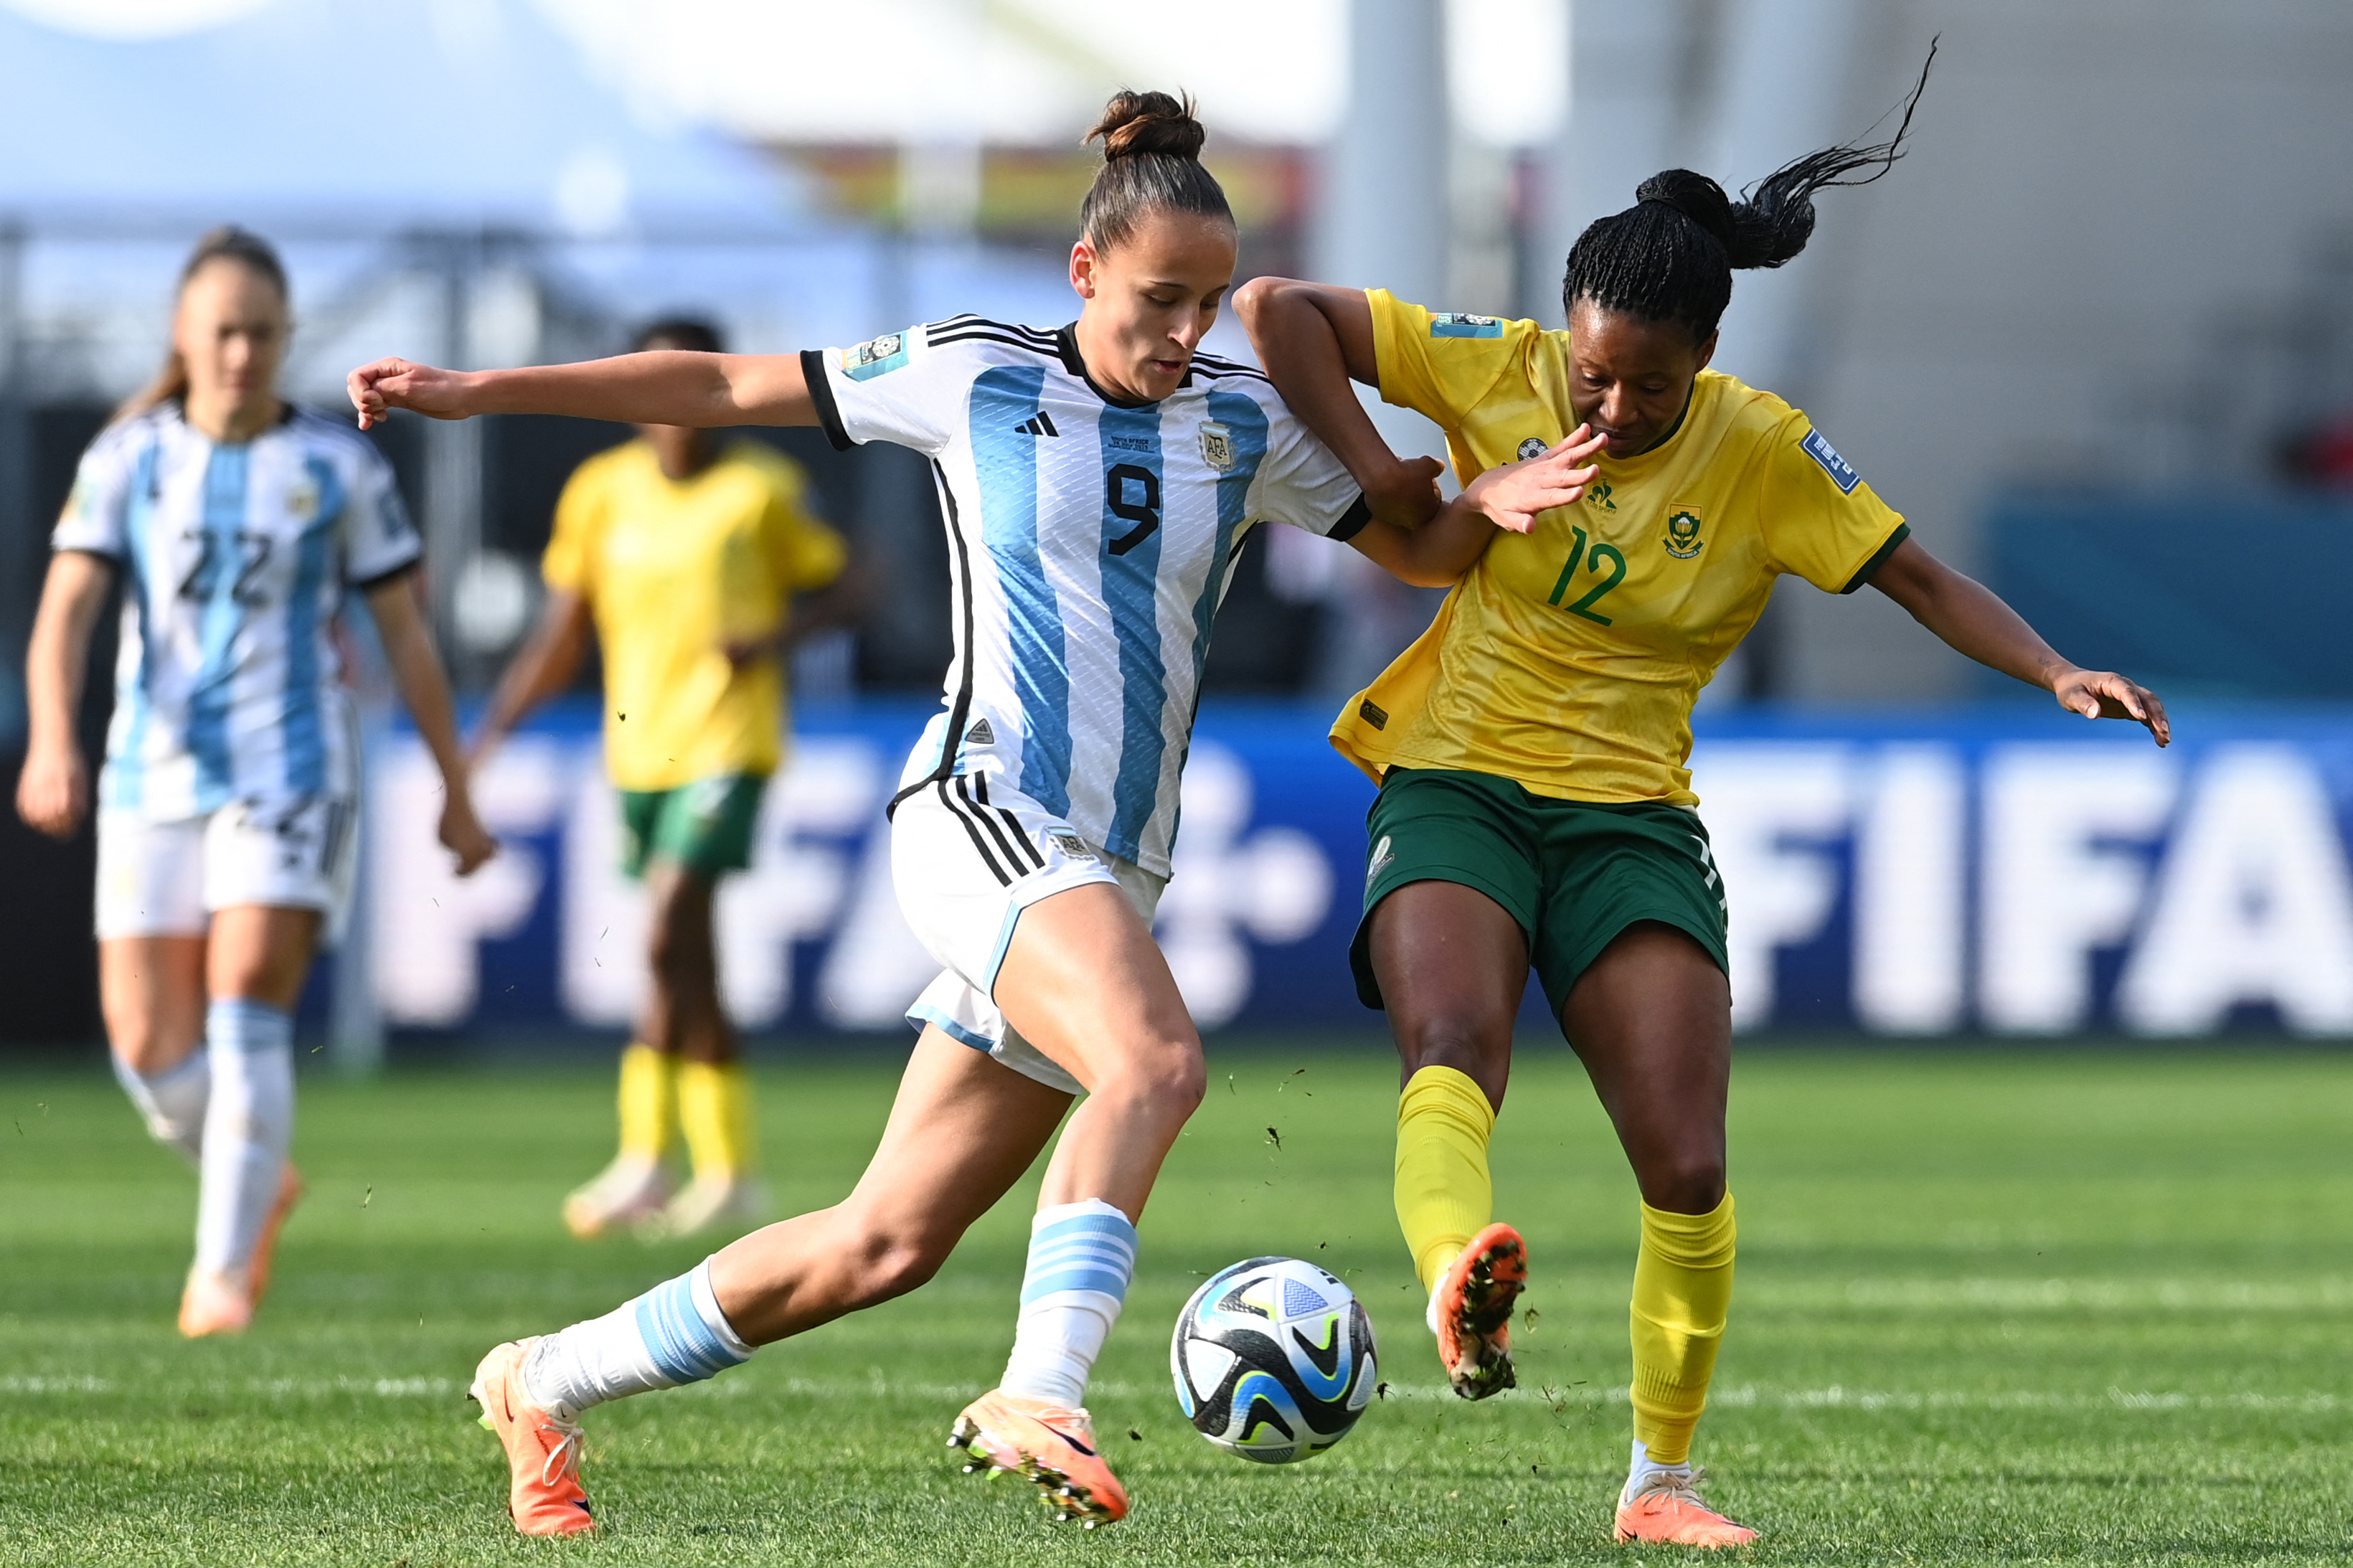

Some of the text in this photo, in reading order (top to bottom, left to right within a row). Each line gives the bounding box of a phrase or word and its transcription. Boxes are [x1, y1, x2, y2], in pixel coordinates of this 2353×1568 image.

[1207, 433, 1227, 459] AFA
[1107, 463, 1160, 557] 9
[176, 526, 273, 613] 22
[1547, 524, 1627, 627] 12
[1060, 834, 1085, 851] AFA
[1687, 737, 2353, 1037] FIFA
